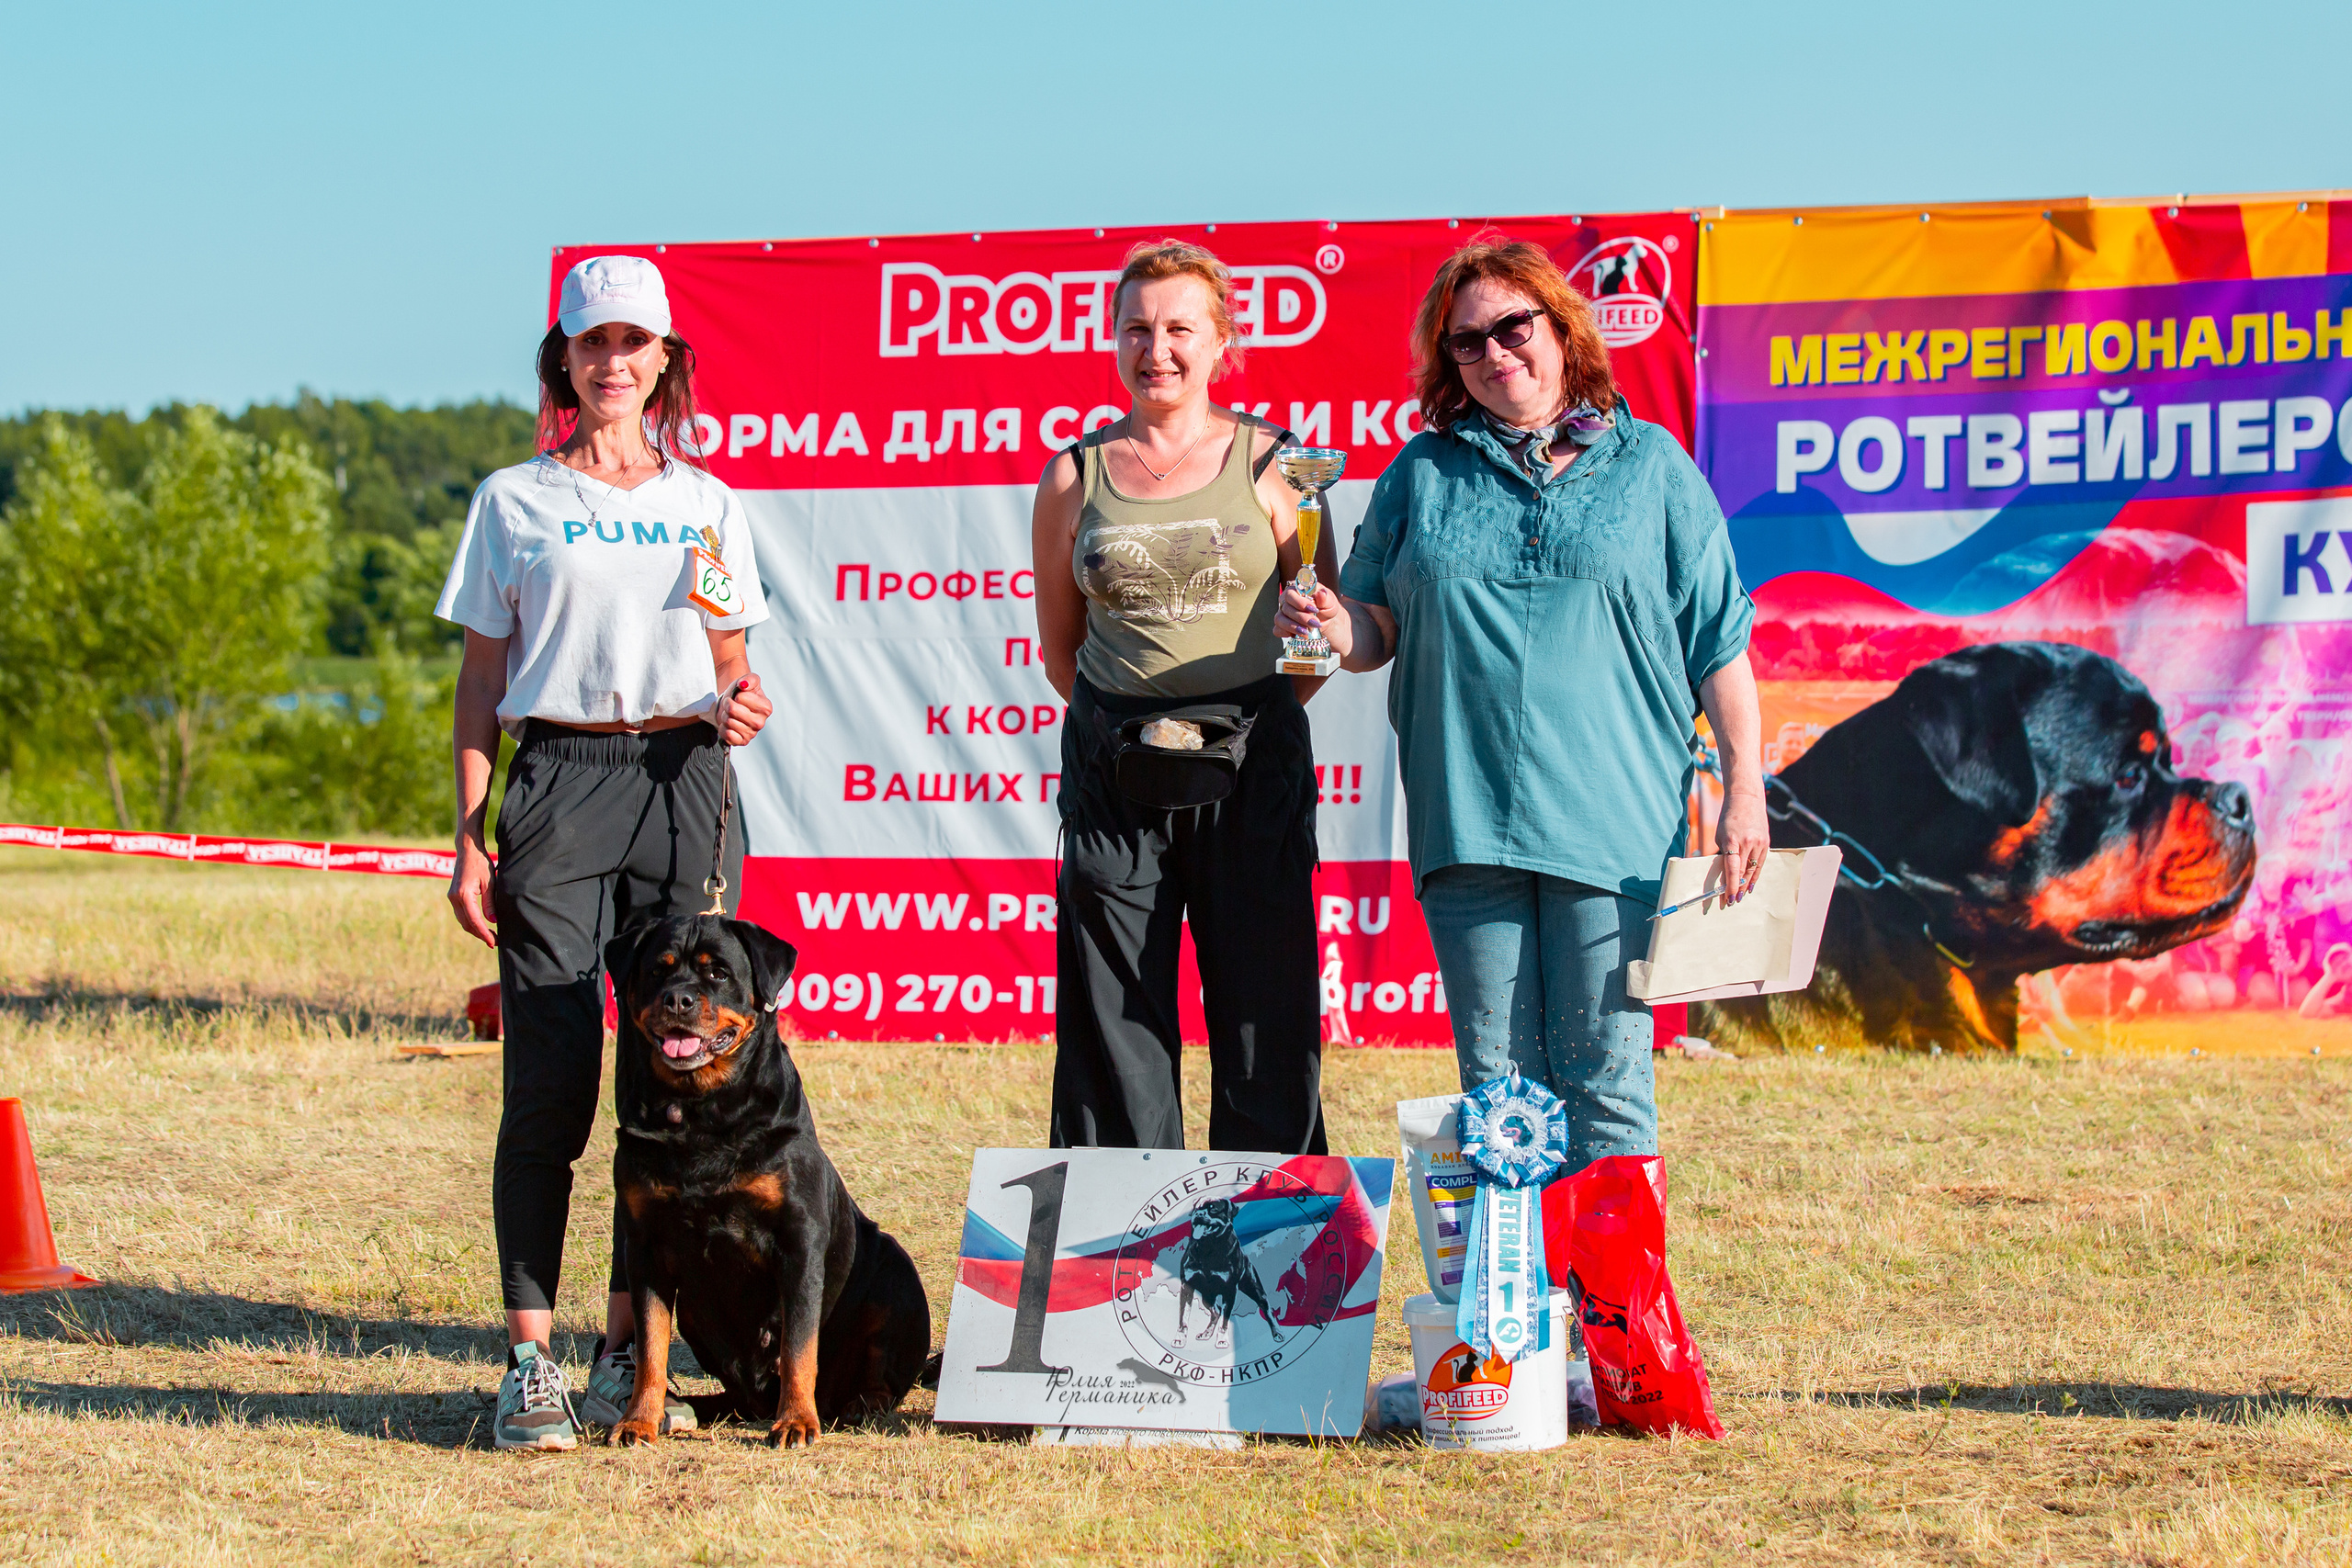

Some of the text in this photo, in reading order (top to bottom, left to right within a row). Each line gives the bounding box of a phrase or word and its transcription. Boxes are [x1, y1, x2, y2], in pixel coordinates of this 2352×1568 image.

[879, 262, 1327, 356] PROFIED
[1770, 307, 2352, 388] МЕЖРЕГИОНАЛЬН
[883, 406, 1022, 463] ДЛЯ
[1290, 400, 1331, 446] И
[563, 520, 707, 546] PUMA
[703, 567, 734, 602] 65
[836, 564, 1035, 601] ПРОФЕС
[926, 705, 1069, 735] К КОР
[843, 763, 1023, 802] ВАШИХ
[797, 892, 1391, 935] WWW.PR RU
[895, 974, 1057, 1014] 270-11
[1430, 1151, 1467, 1164] AMI
[1431, 1175, 1477, 1187] COMPL
[1498, 1187, 1522, 1273] VETERAN
[1117, 1166, 1343, 1332] РОТВЕЙЛЕР КЛУБ РОССИИ
[976, 1161, 1069, 1374] 1
[1498, 1281, 1513, 1312] 1
[1046, 1365, 1136, 1388] Юлия 2022
[1159, 1352, 1284, 1383] РКФ-НКПР
[1046, 1374, 1177, 1422] Германика
[1421, 1385, 1509, 1407] PROFIFEED
[1630, 1389, 1665, 1405] 2022
[1425, 1425, 1514, 1436] Профессиоальный подход
